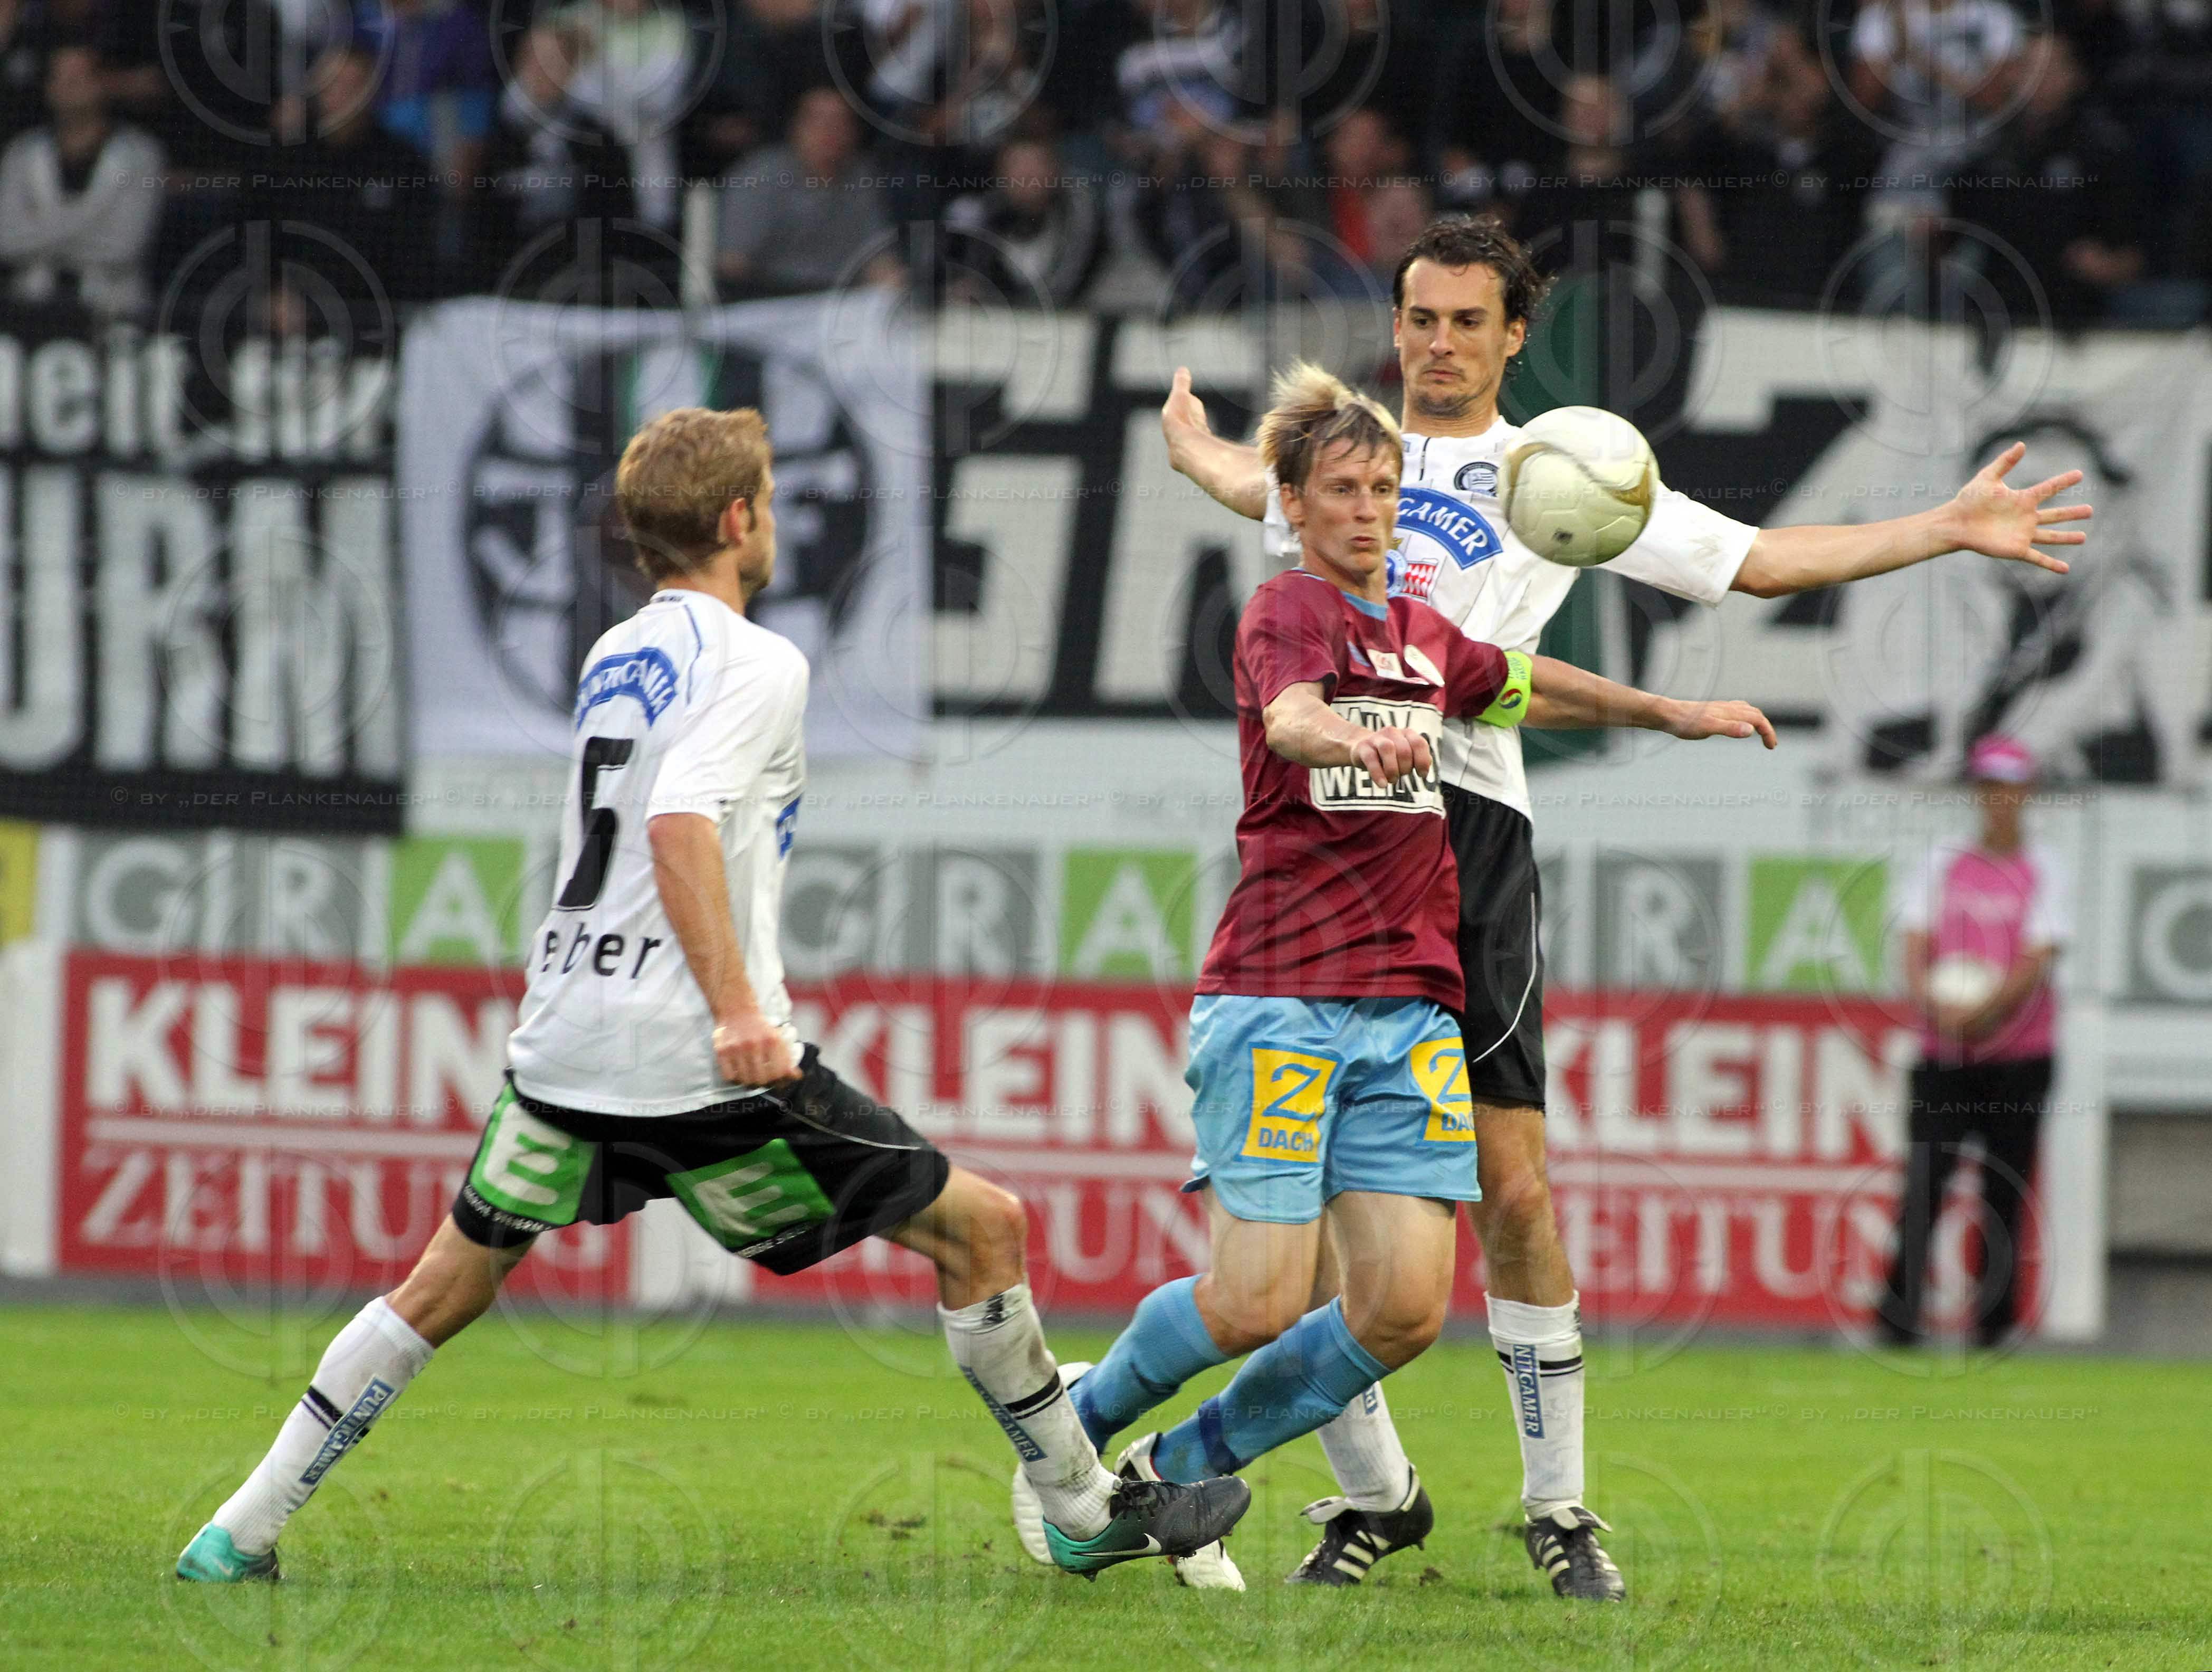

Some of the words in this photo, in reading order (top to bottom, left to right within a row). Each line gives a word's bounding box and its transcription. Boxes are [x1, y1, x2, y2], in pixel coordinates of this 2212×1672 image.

[552, 736, 634, 912] 5
[86, 977, 525, 1132] KLEIN
[794, 1000, 1194, 1154] KLEIN
[1258, 1127, 1314, 1152] DACH
